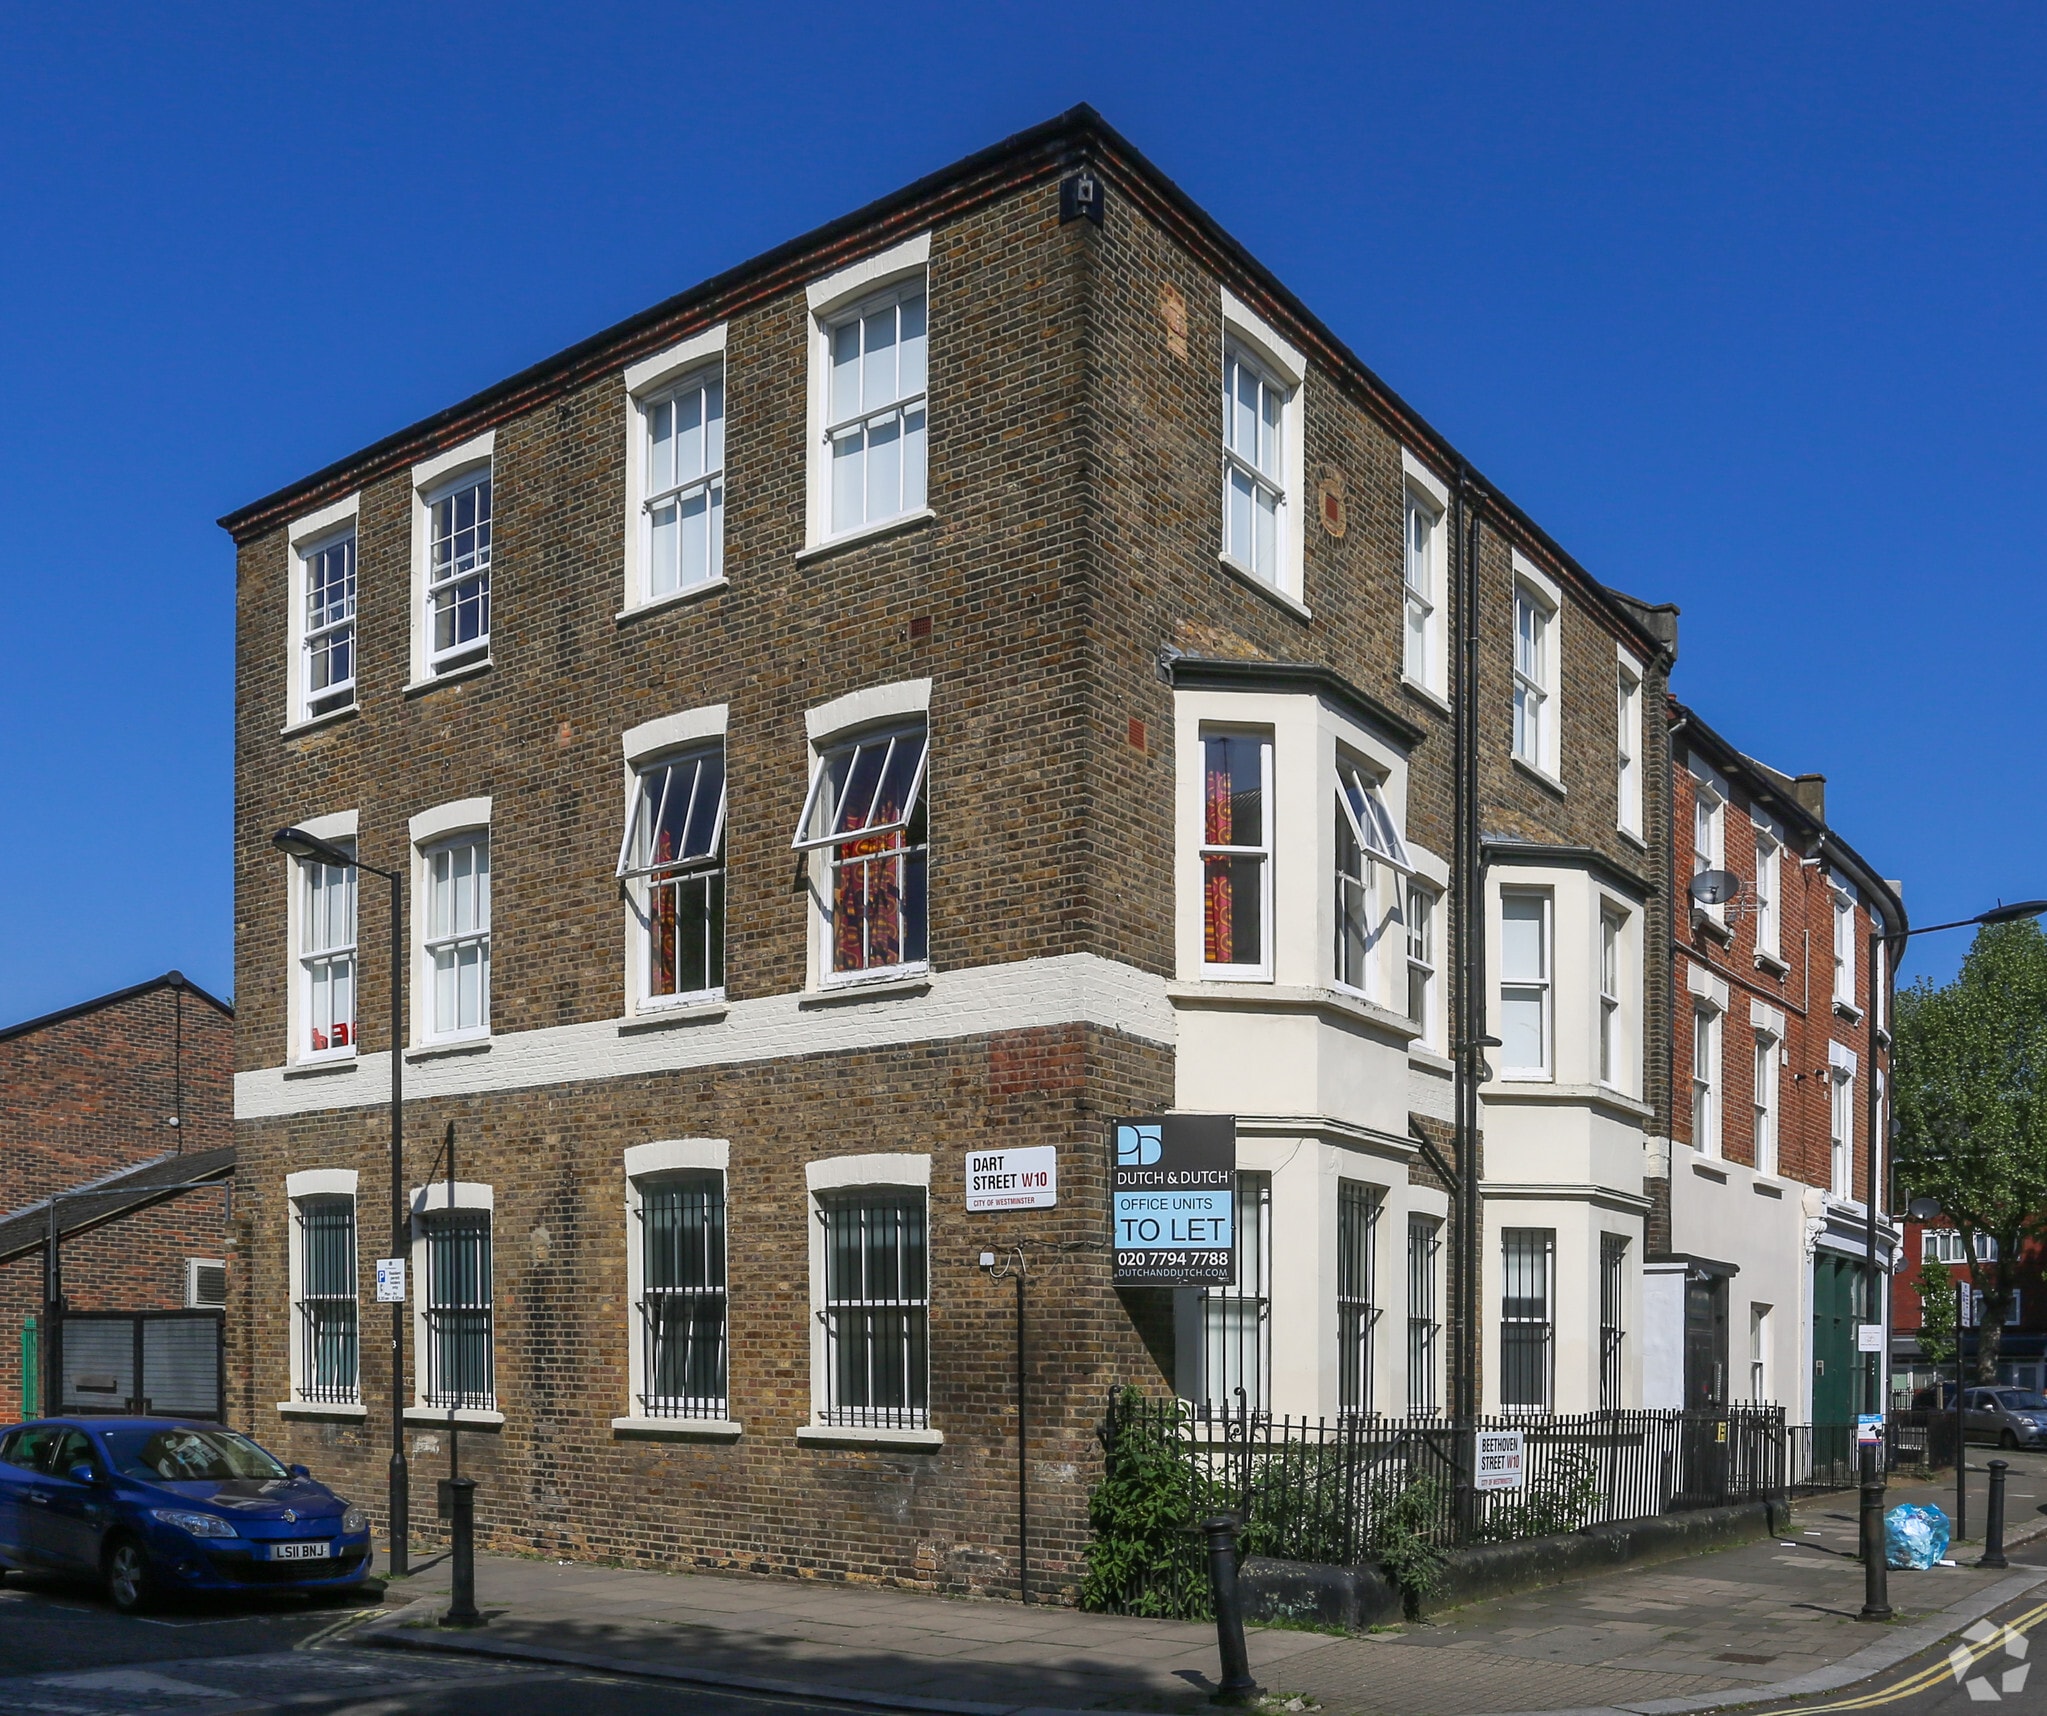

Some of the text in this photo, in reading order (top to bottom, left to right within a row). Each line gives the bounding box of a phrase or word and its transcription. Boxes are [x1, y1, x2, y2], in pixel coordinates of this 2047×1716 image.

[973, 1156, 1005, 1172] DART
[973, 1171, 1047, 1191] STREET W10
[1117, 1170, 1228, 1185] DUTCH & DUTCH
[973, 1196, 1035, 1207] CITY OF WESTMINSTER
[1120, 1197, 1213, 1210] OFFICE UNITS
[1120, 1218, 1226, 1242] TO LET
[1117, 1251, 1229, 1266] 020 7794 7788
[1118, 1268, 1228, 1277] DUTCHANDDUTCH.COM
[1481, 1437, 1518, 1452] BEETHOVEN
[1481, 1454, 1520, 1470] STREET W10
[276, 1544, 324, 1558] LS11 BNJ
